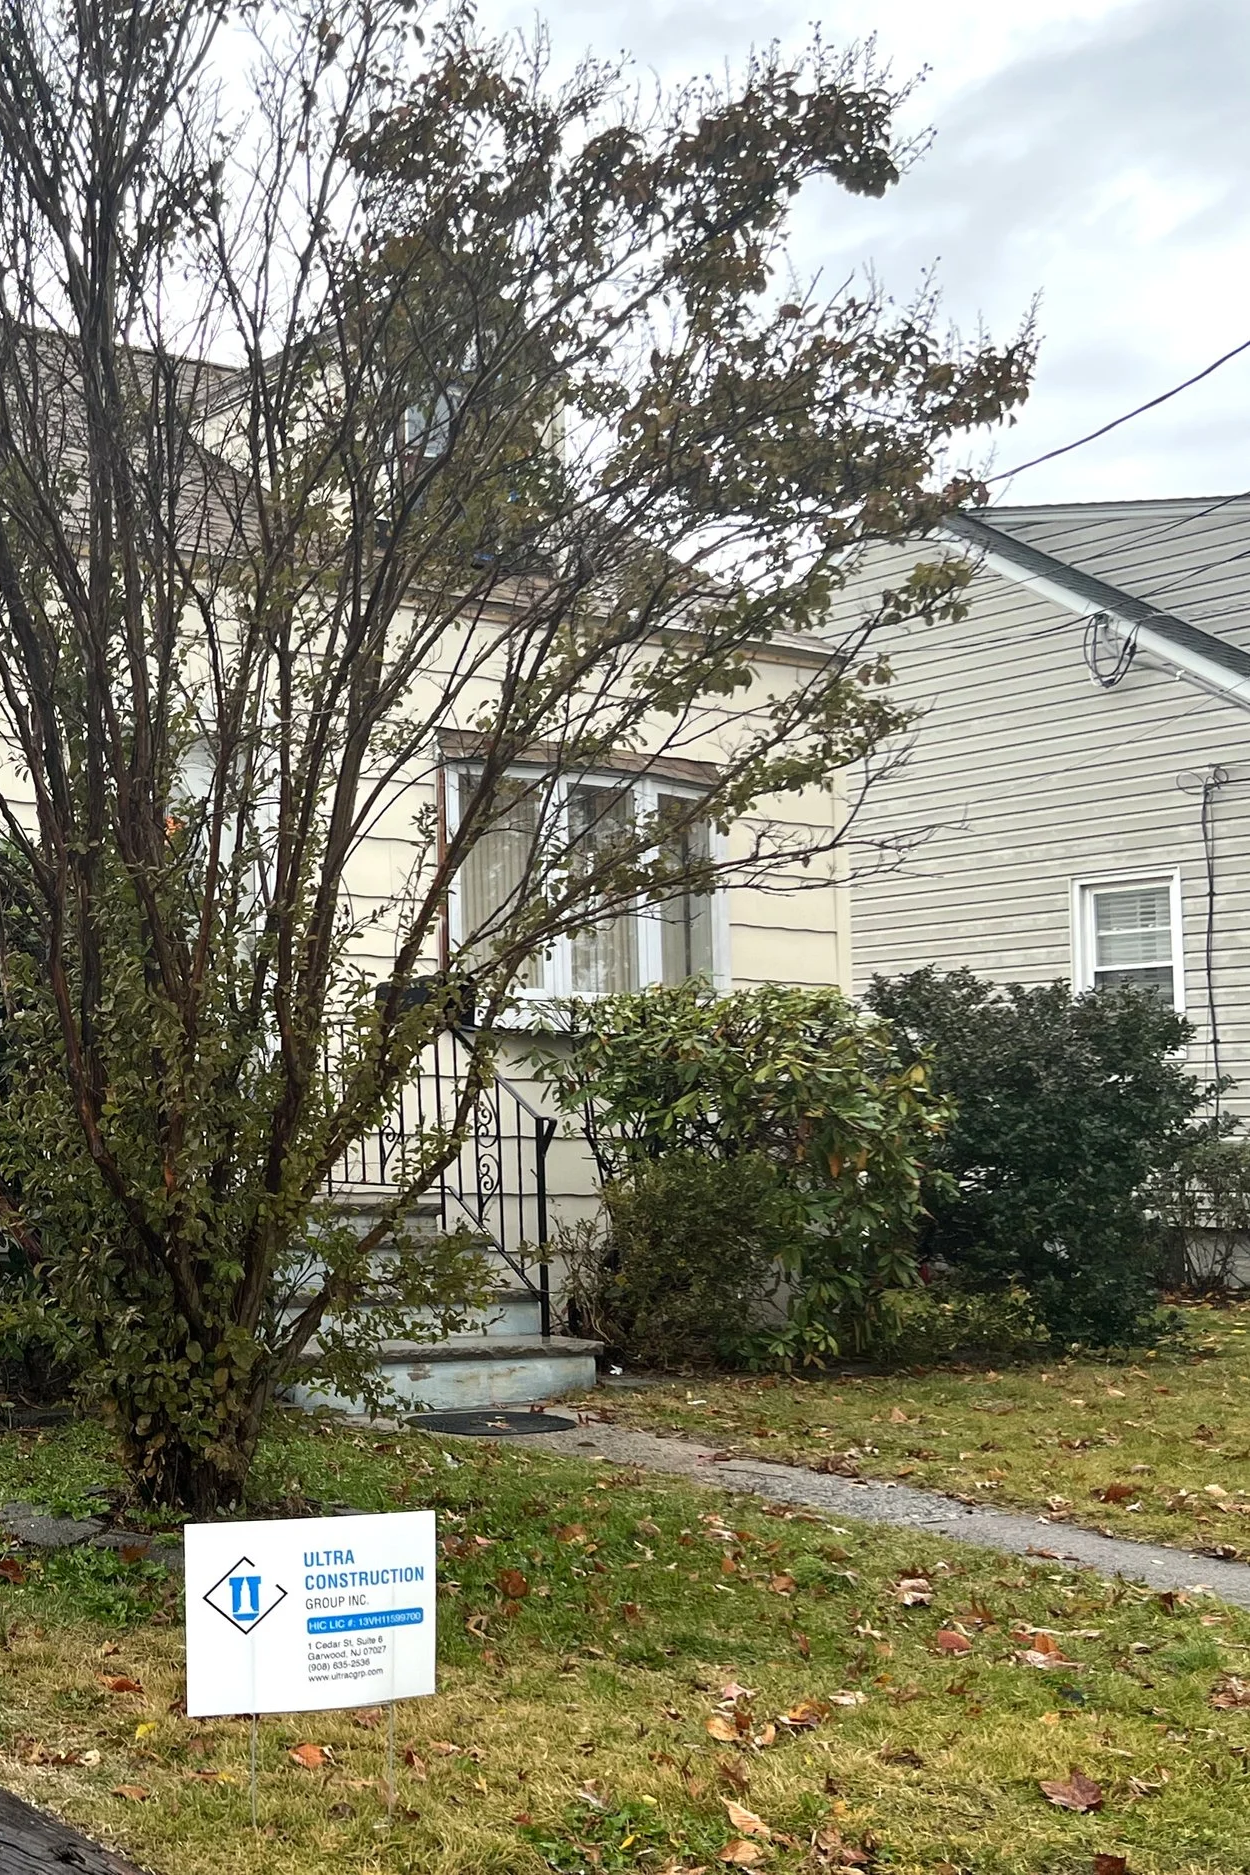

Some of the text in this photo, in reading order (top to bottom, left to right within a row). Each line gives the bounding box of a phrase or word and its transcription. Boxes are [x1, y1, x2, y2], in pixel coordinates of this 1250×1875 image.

[304, 1549, 355, 1567] ULTRA
[305, 1566, 424, 1590] CONSTRUCTION
[305, 1594, 369, 1610] GROUP INC.
[308, 1621, 327, 1631] HIC
[329, 1619, 345, 1629] LIC
[307, 1642, 312, 1650] 1
[315, 1640, 341, 1650] Cedar
[356, 1637, 376, 1646] Suite
[350, 1648, 362, 1657] NJ
[363, 1645, 387, 1656] 07027
[308, 1661, 331, 1673] (908)
